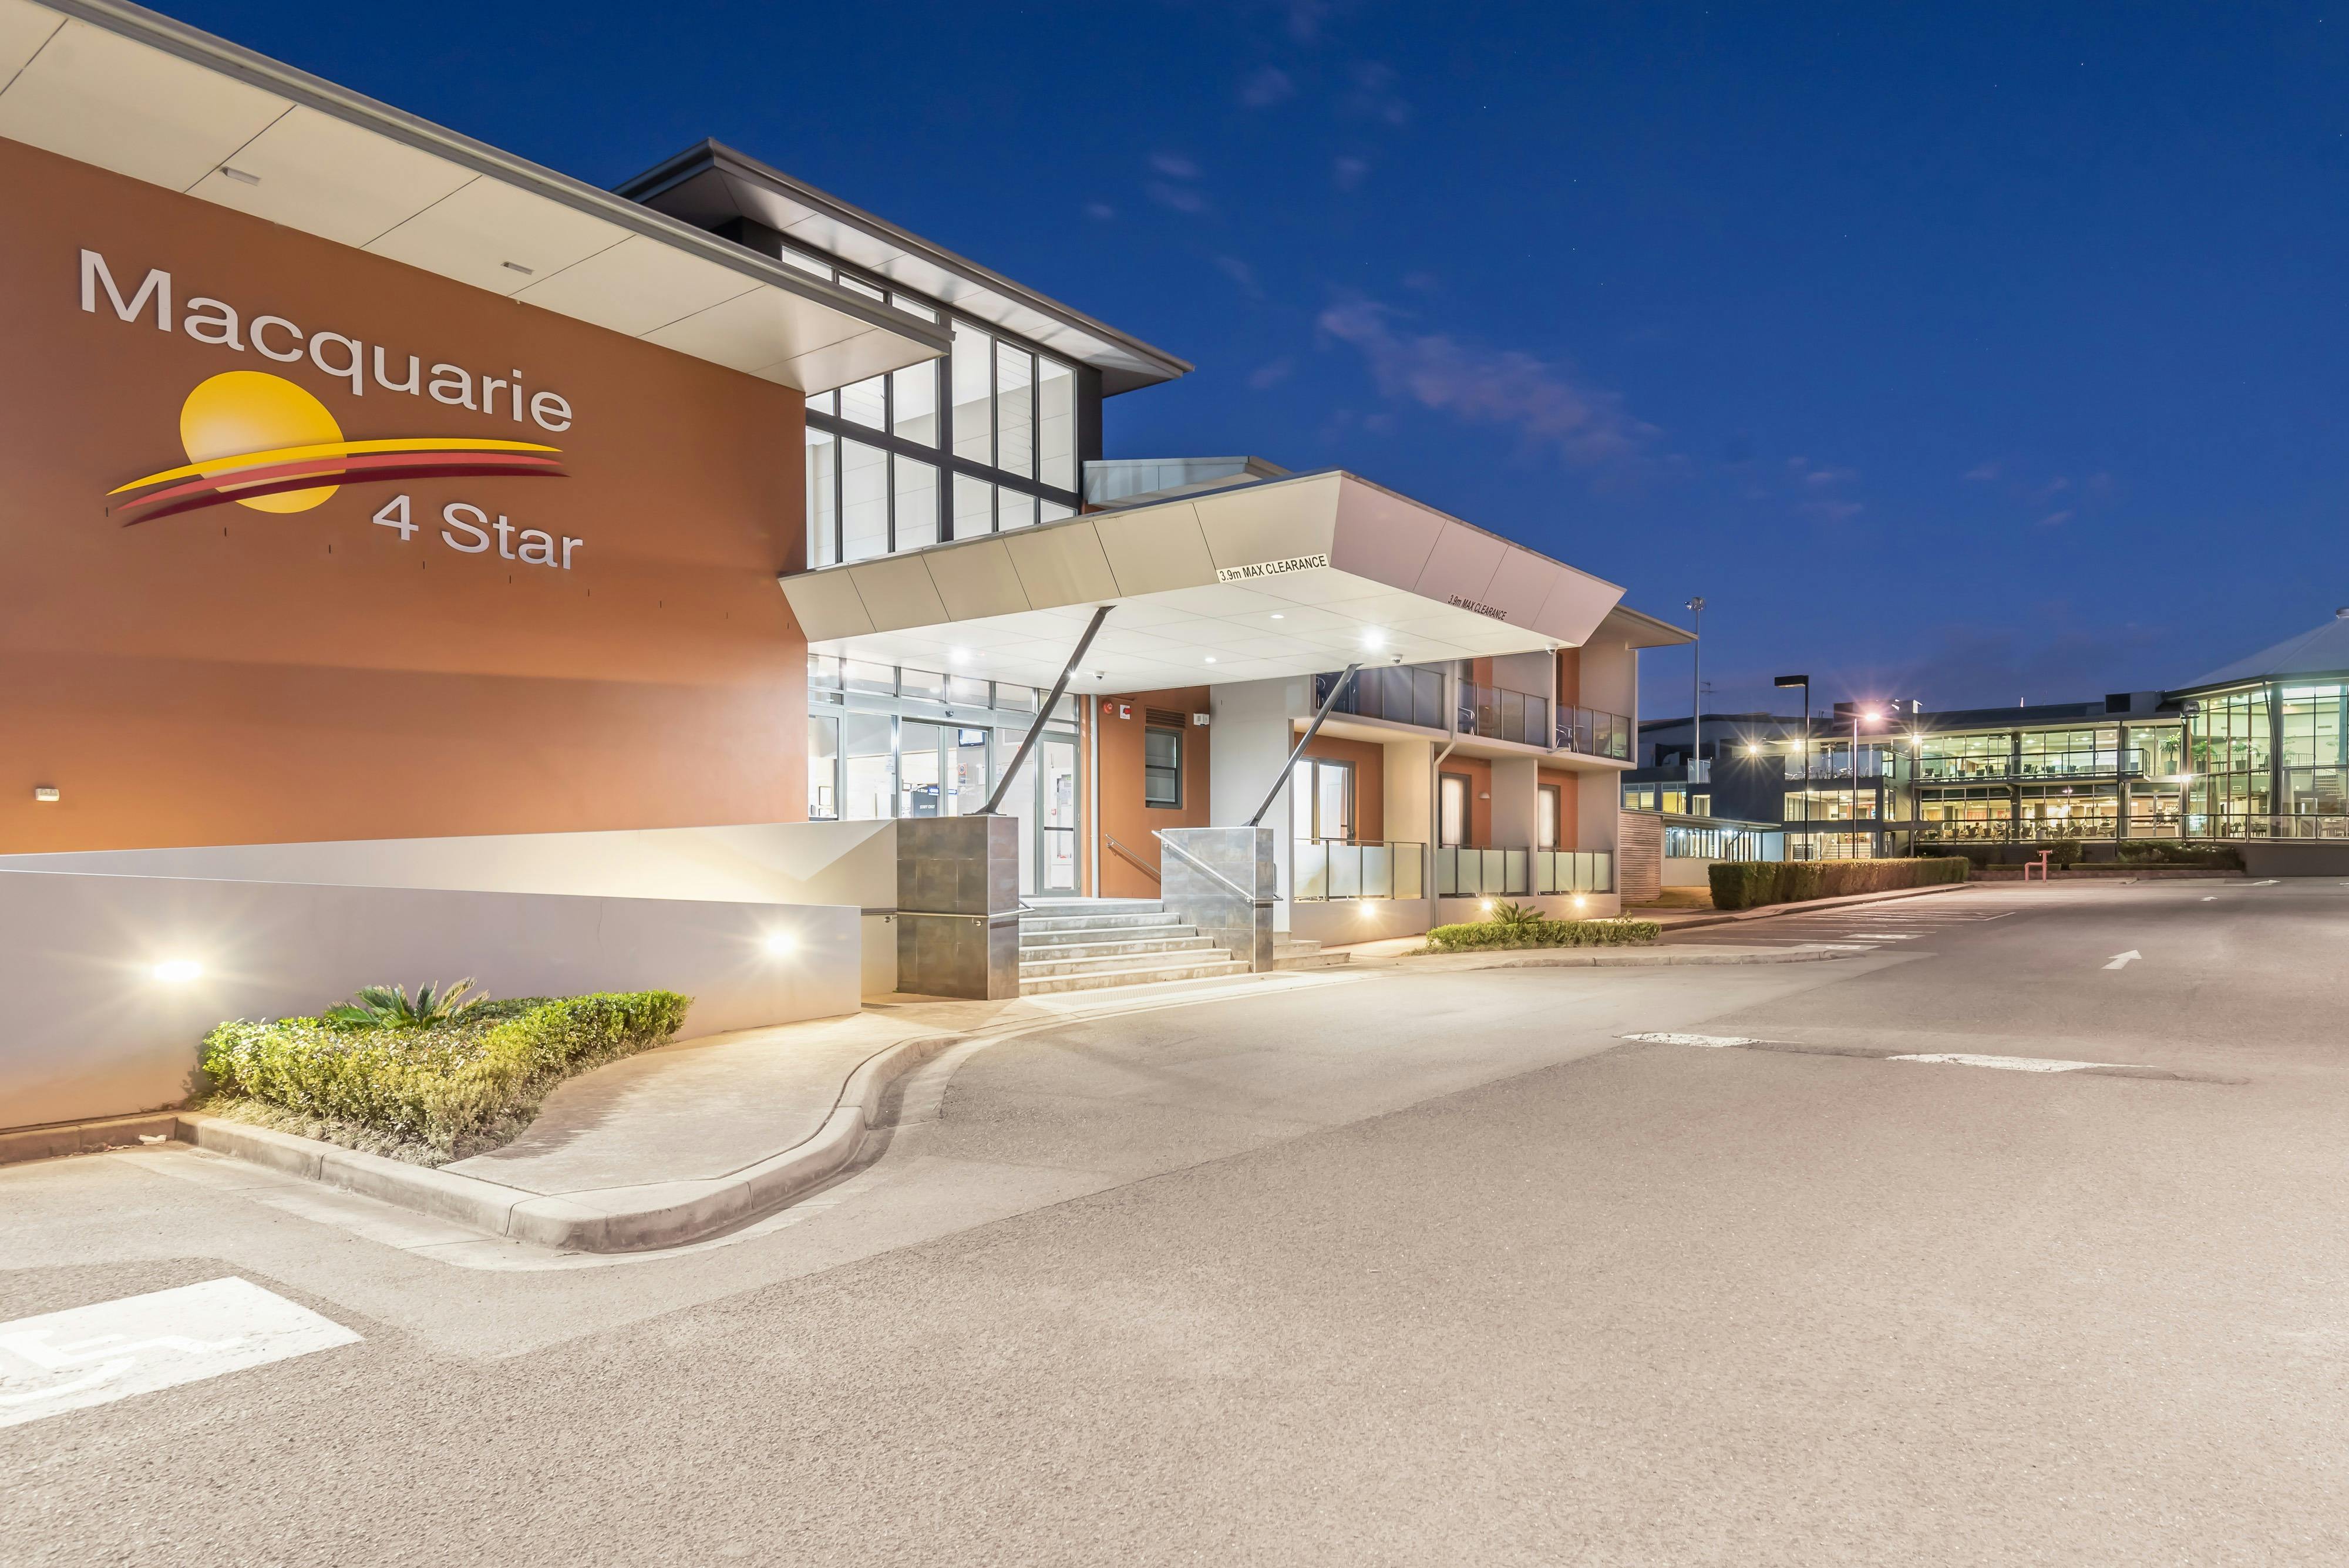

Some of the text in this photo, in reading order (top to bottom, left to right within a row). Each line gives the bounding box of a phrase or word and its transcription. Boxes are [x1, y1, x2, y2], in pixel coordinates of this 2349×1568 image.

[80, 248, 573, 433] Macquarie
[372, 494, 584, 571] 4 Star
[1220, 555, 1327, 581] 3.9m MAX CLEARANCE
[1448, 594, 1507, 621] 3.9m MAX CLEARANCE
